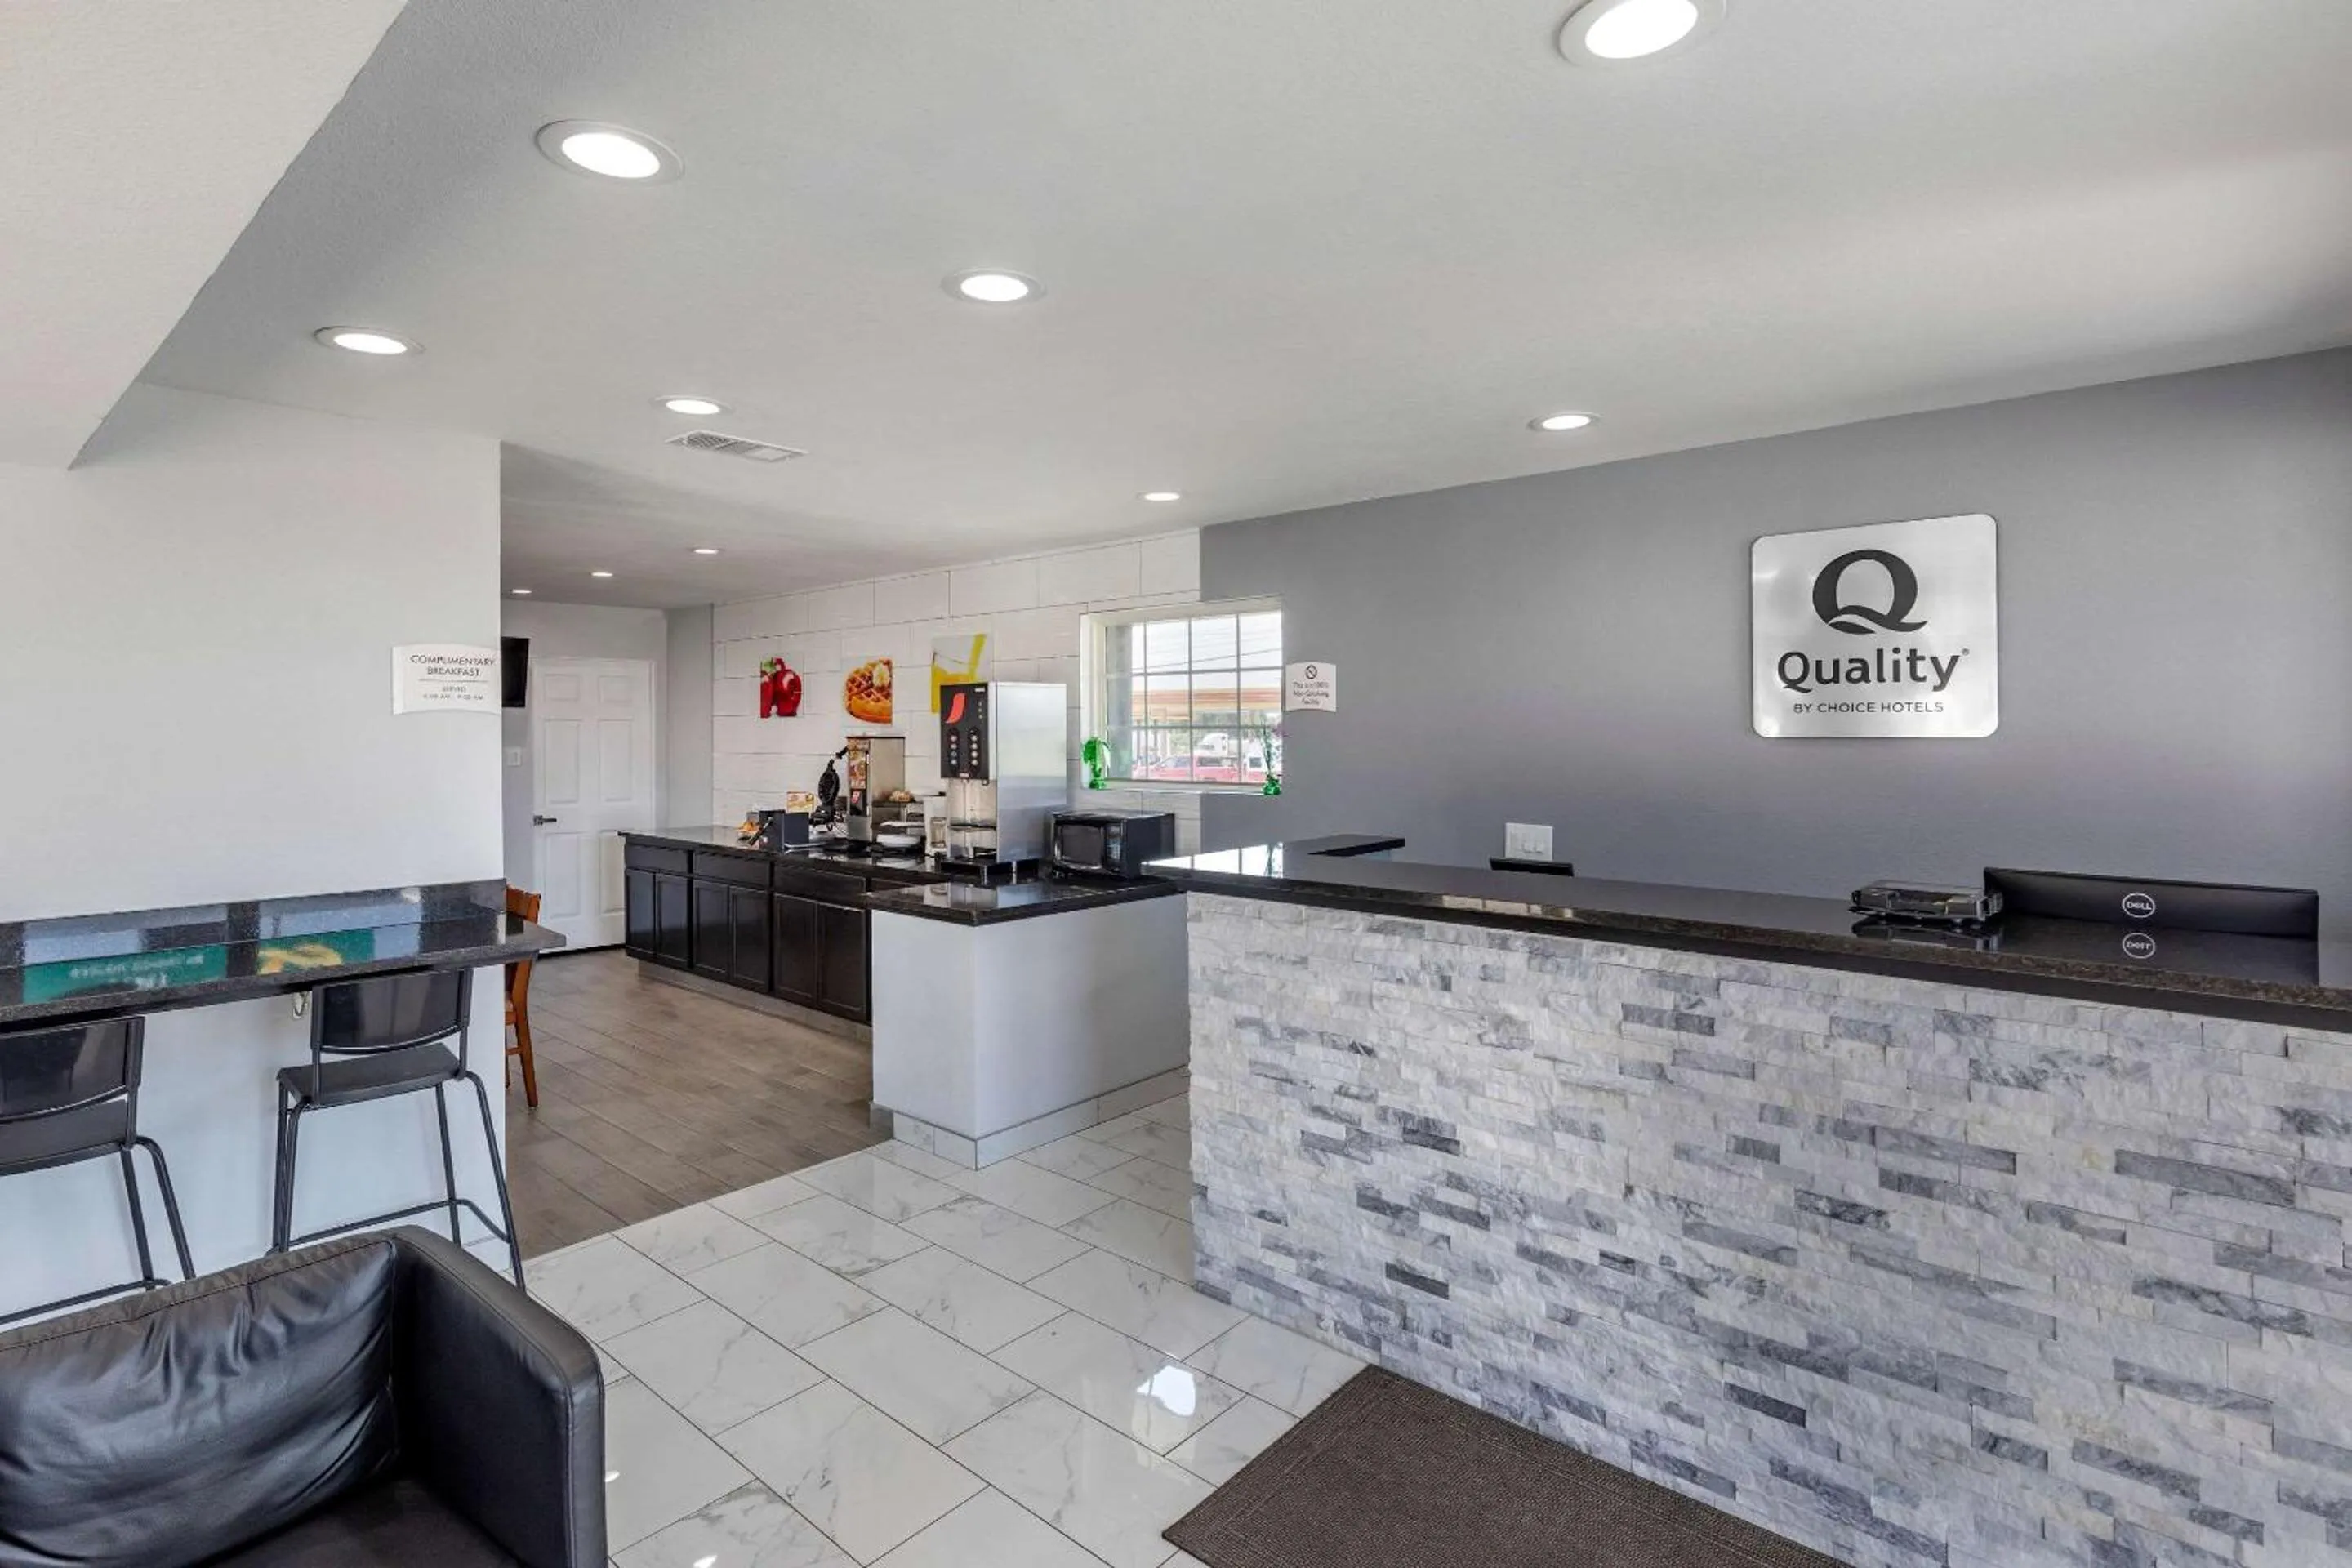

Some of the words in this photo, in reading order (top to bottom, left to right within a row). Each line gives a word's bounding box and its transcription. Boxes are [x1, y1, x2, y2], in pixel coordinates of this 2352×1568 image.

[1812, 550, 1928, 635] Q
[410, 654, 496, 666] COMPLIMENTARY
[427, 666, 480, 677] BREAKFAST
[1777, 647, 1961, 693] Quality
[1793, 702, 1812, 714] BY
[1817, 702, 1876, 713] CHOICE
[1881, 702, 1944, 713] HOTELS
[2126, 901, 2152, 911] DELL
